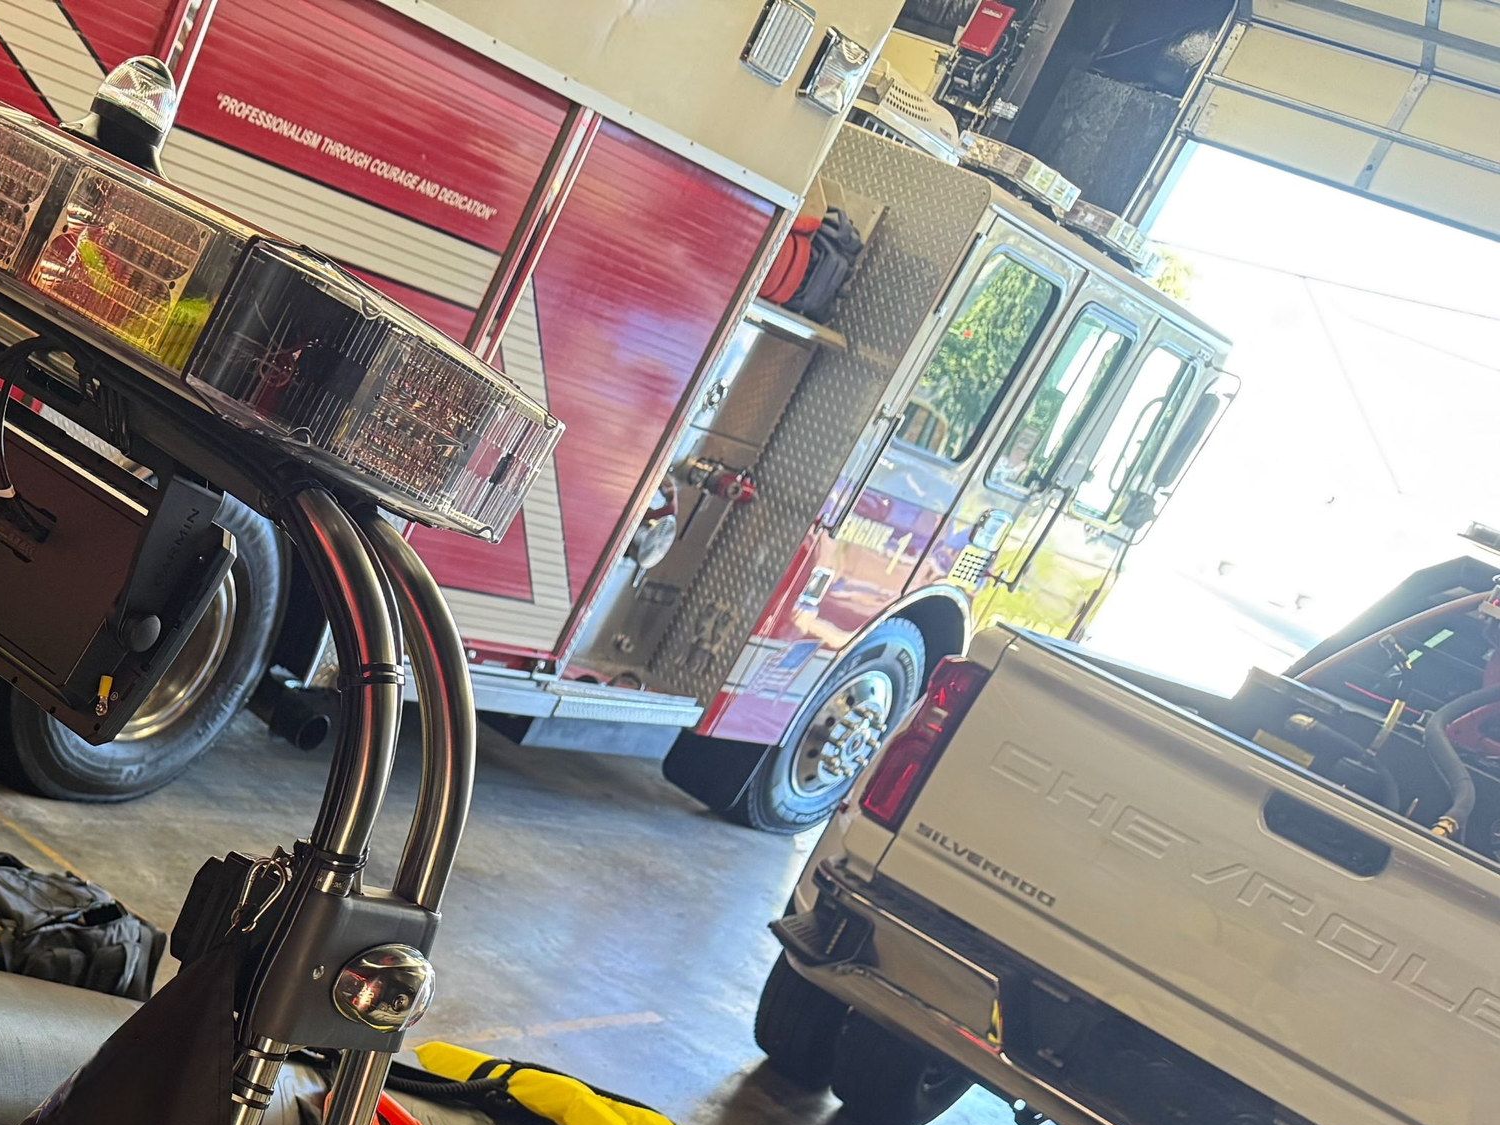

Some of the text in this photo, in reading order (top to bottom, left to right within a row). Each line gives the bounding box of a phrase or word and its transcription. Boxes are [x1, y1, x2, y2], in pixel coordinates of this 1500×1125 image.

[217, 92, 498, 220] "PROFESSIONALISM THROUGH COURAGE AND DEDICATION"
[153, 507, 200, 588] GARMIN
[885, 532, 913, 575] 1
[915, 821, 1057, 907] SILVERADO
